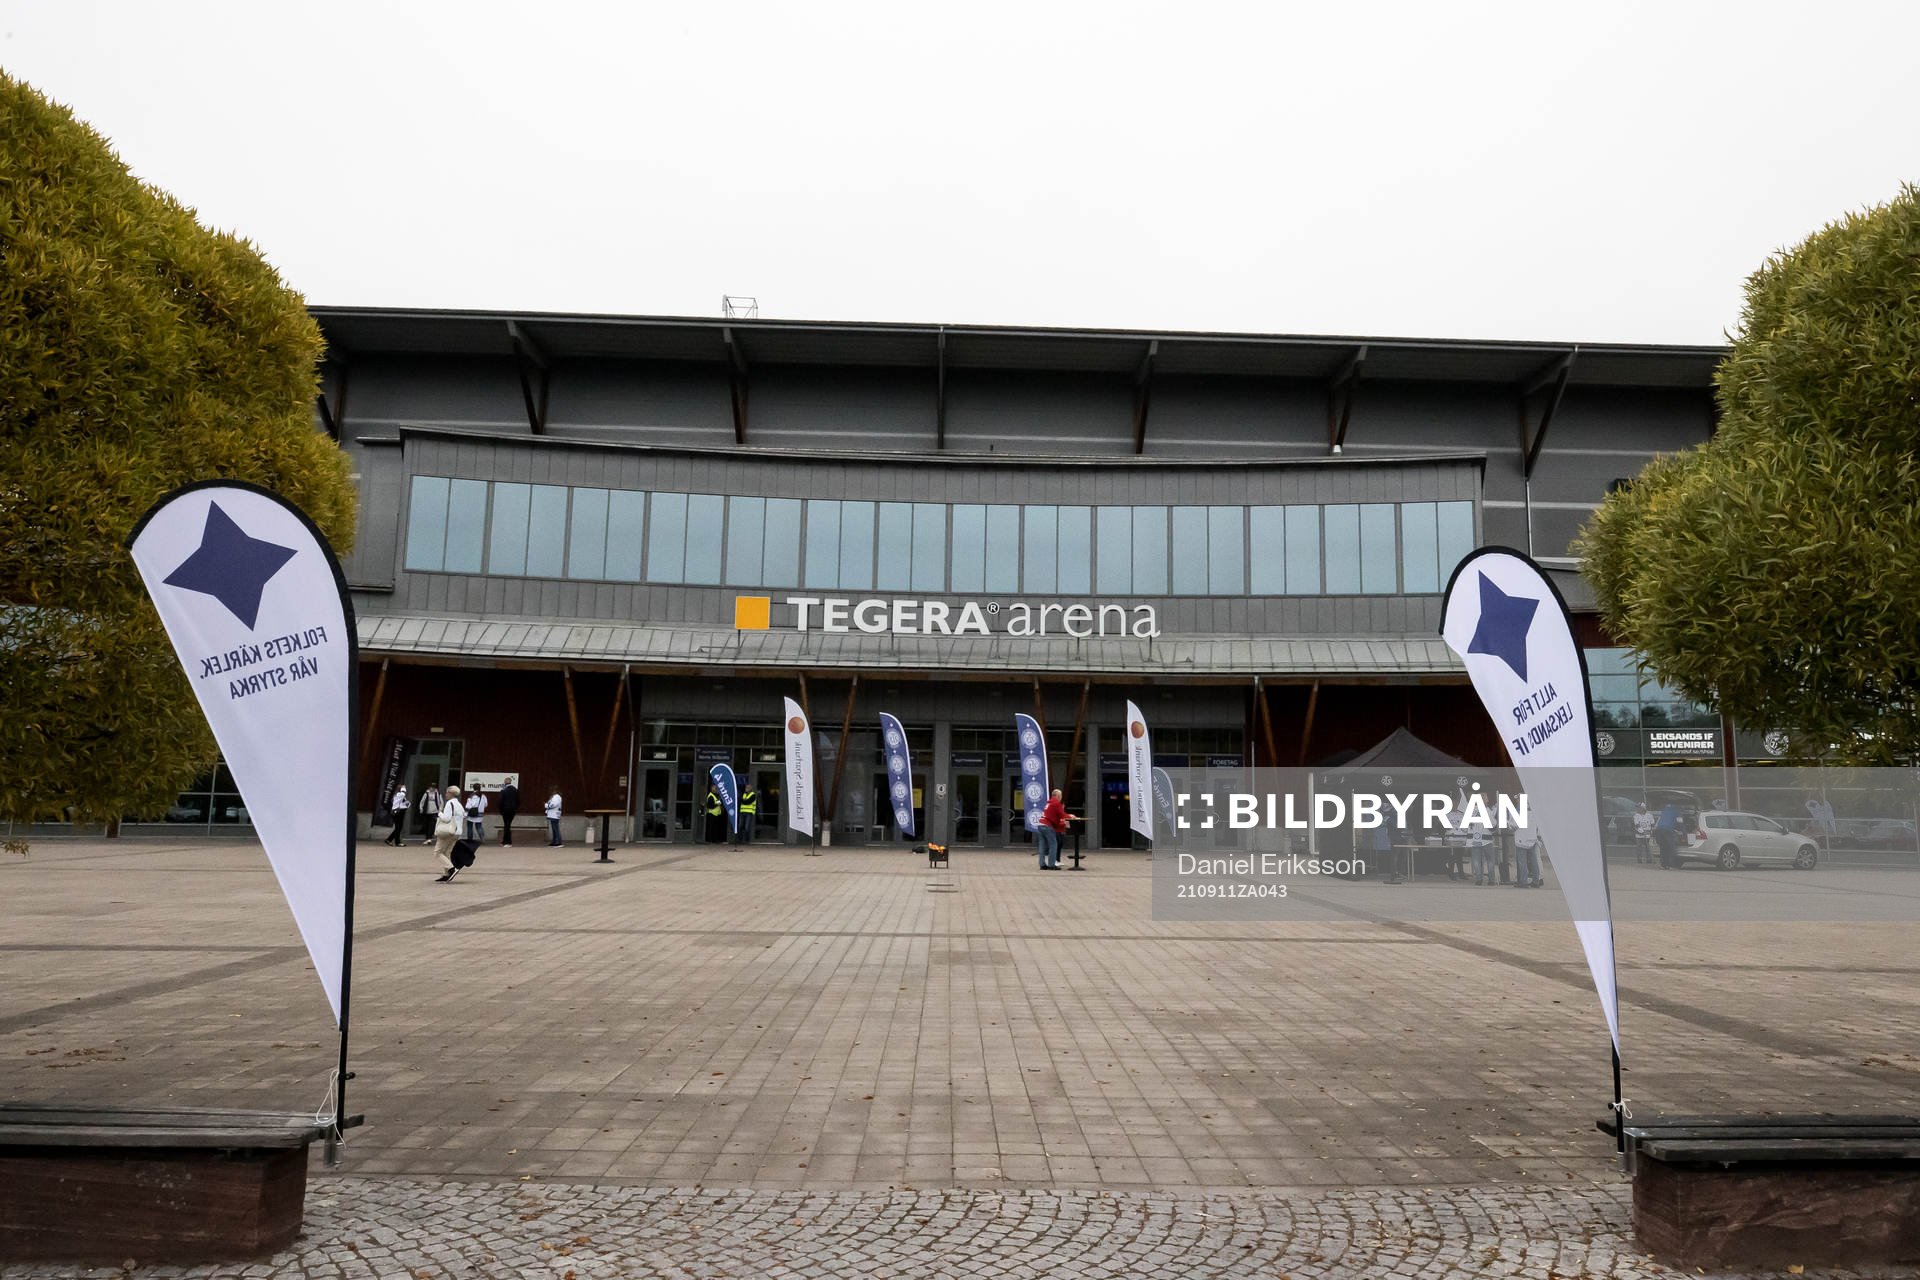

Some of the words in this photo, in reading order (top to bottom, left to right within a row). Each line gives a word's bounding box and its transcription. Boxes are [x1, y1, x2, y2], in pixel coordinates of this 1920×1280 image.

[1007, 601, 1161, 638] arena
[1650, 732, 1703, 741] LEKSANDS
[1704, 732, 1714, 741] IF
[1650, 741, 1715, 749] SOUVENIRER
